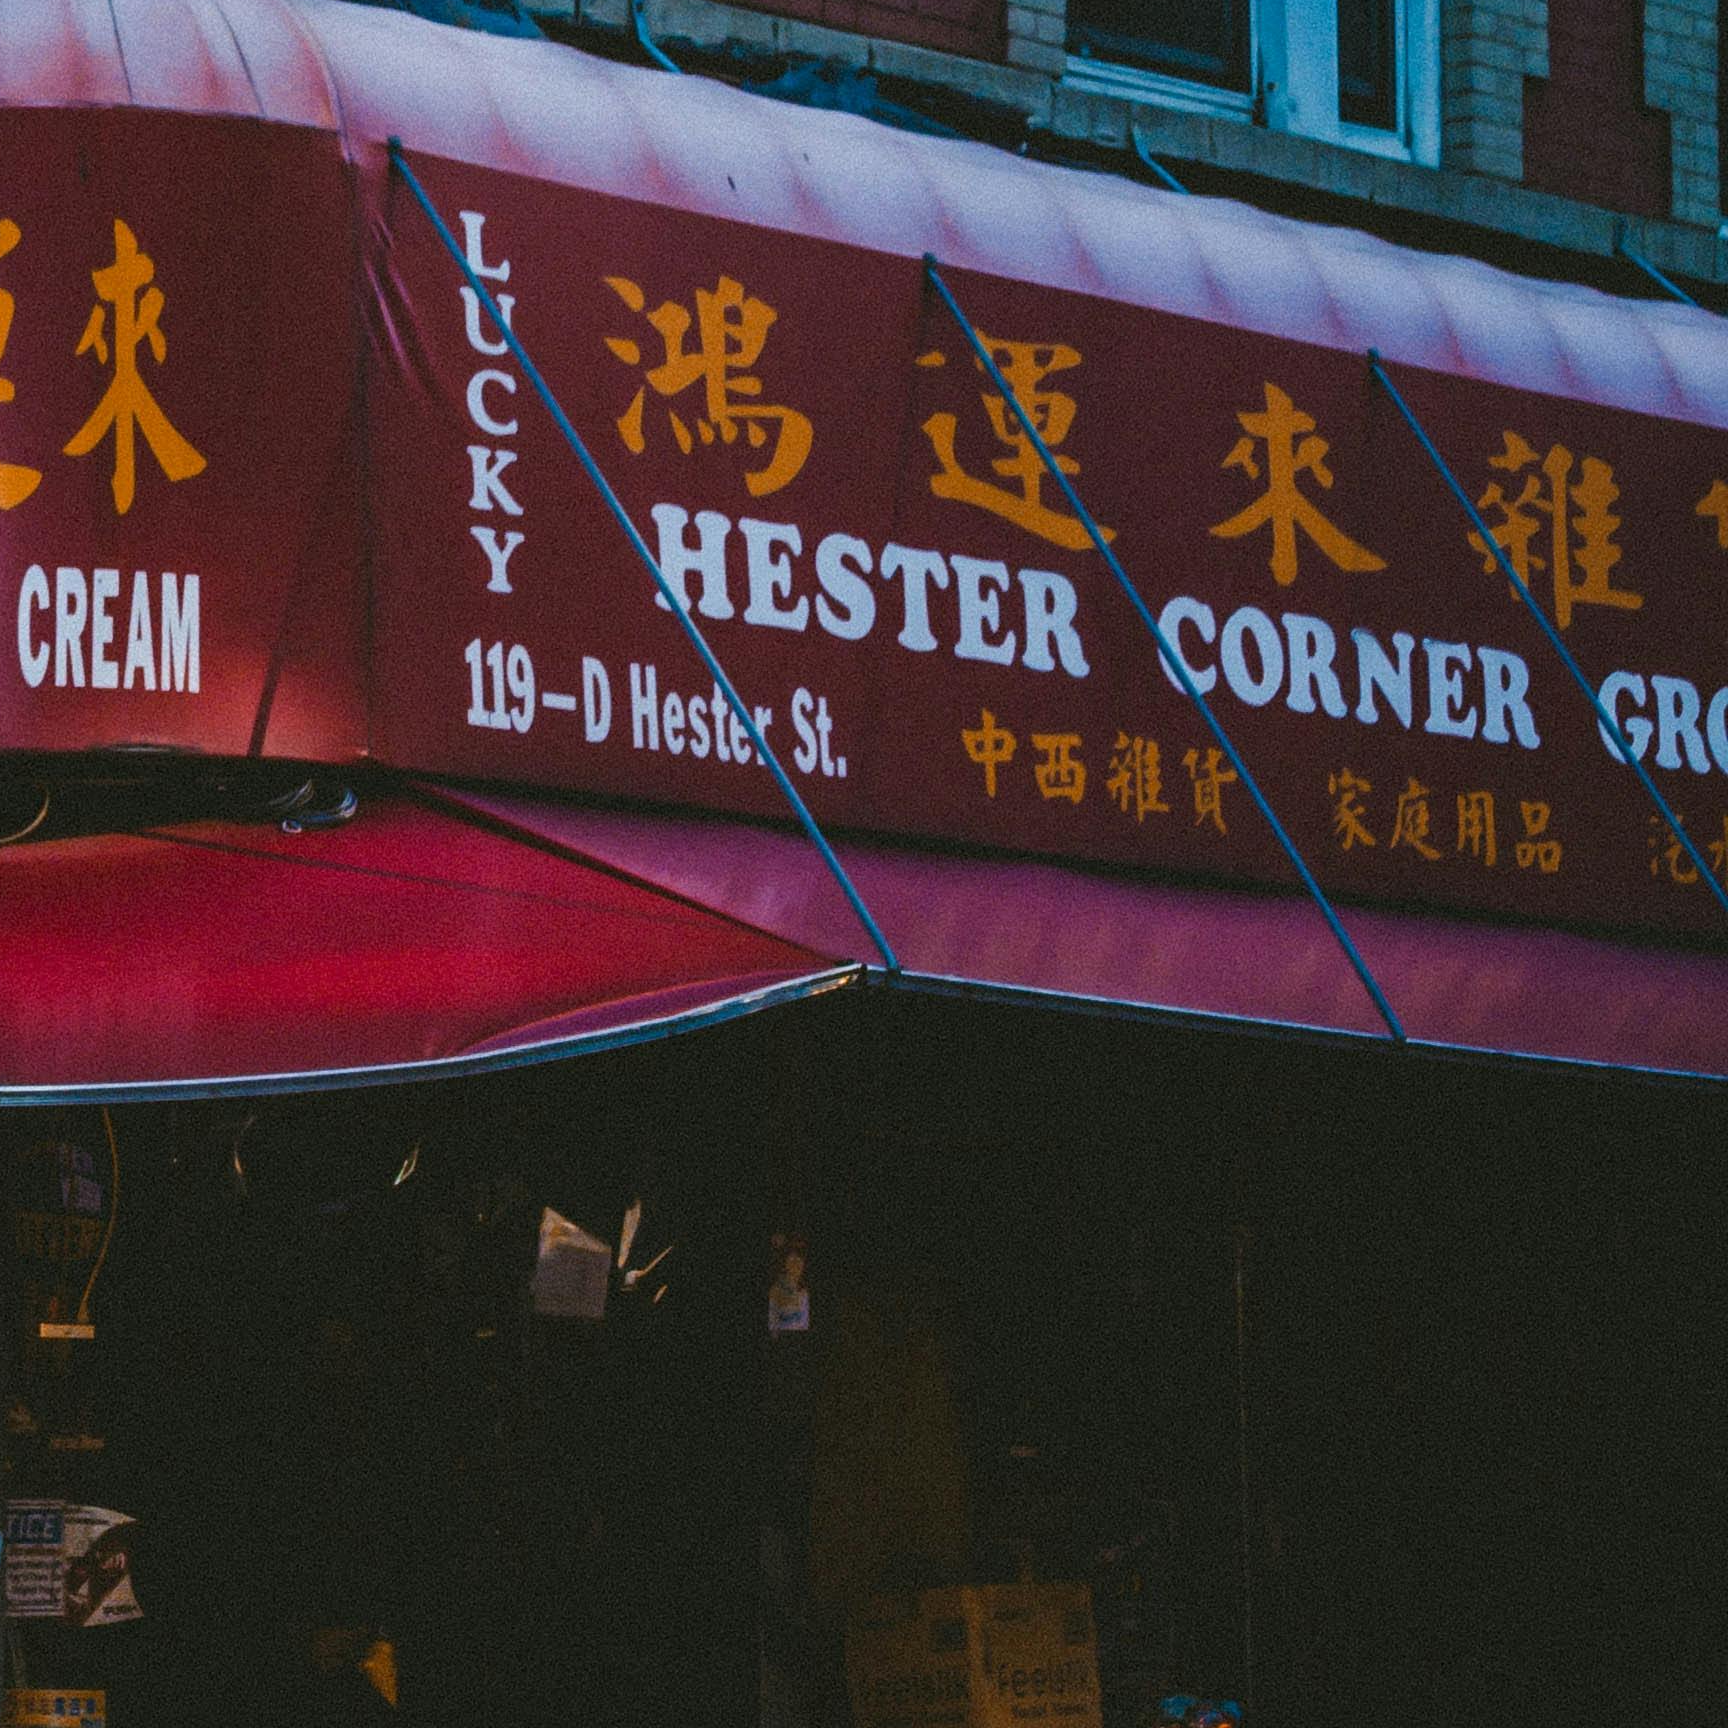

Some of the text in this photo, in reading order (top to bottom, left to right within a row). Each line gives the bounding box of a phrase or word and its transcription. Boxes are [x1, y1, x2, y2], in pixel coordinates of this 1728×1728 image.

[459, 211, 524, 594] LUCKY
[17, 564, 202, 694] CREAM
[630, 660, 772, 766] Hester
[791, 687, 848, 778] St.
[649, 503, 1090, 677] HESTER
[1156, 596, 1539, 749] CORNER
